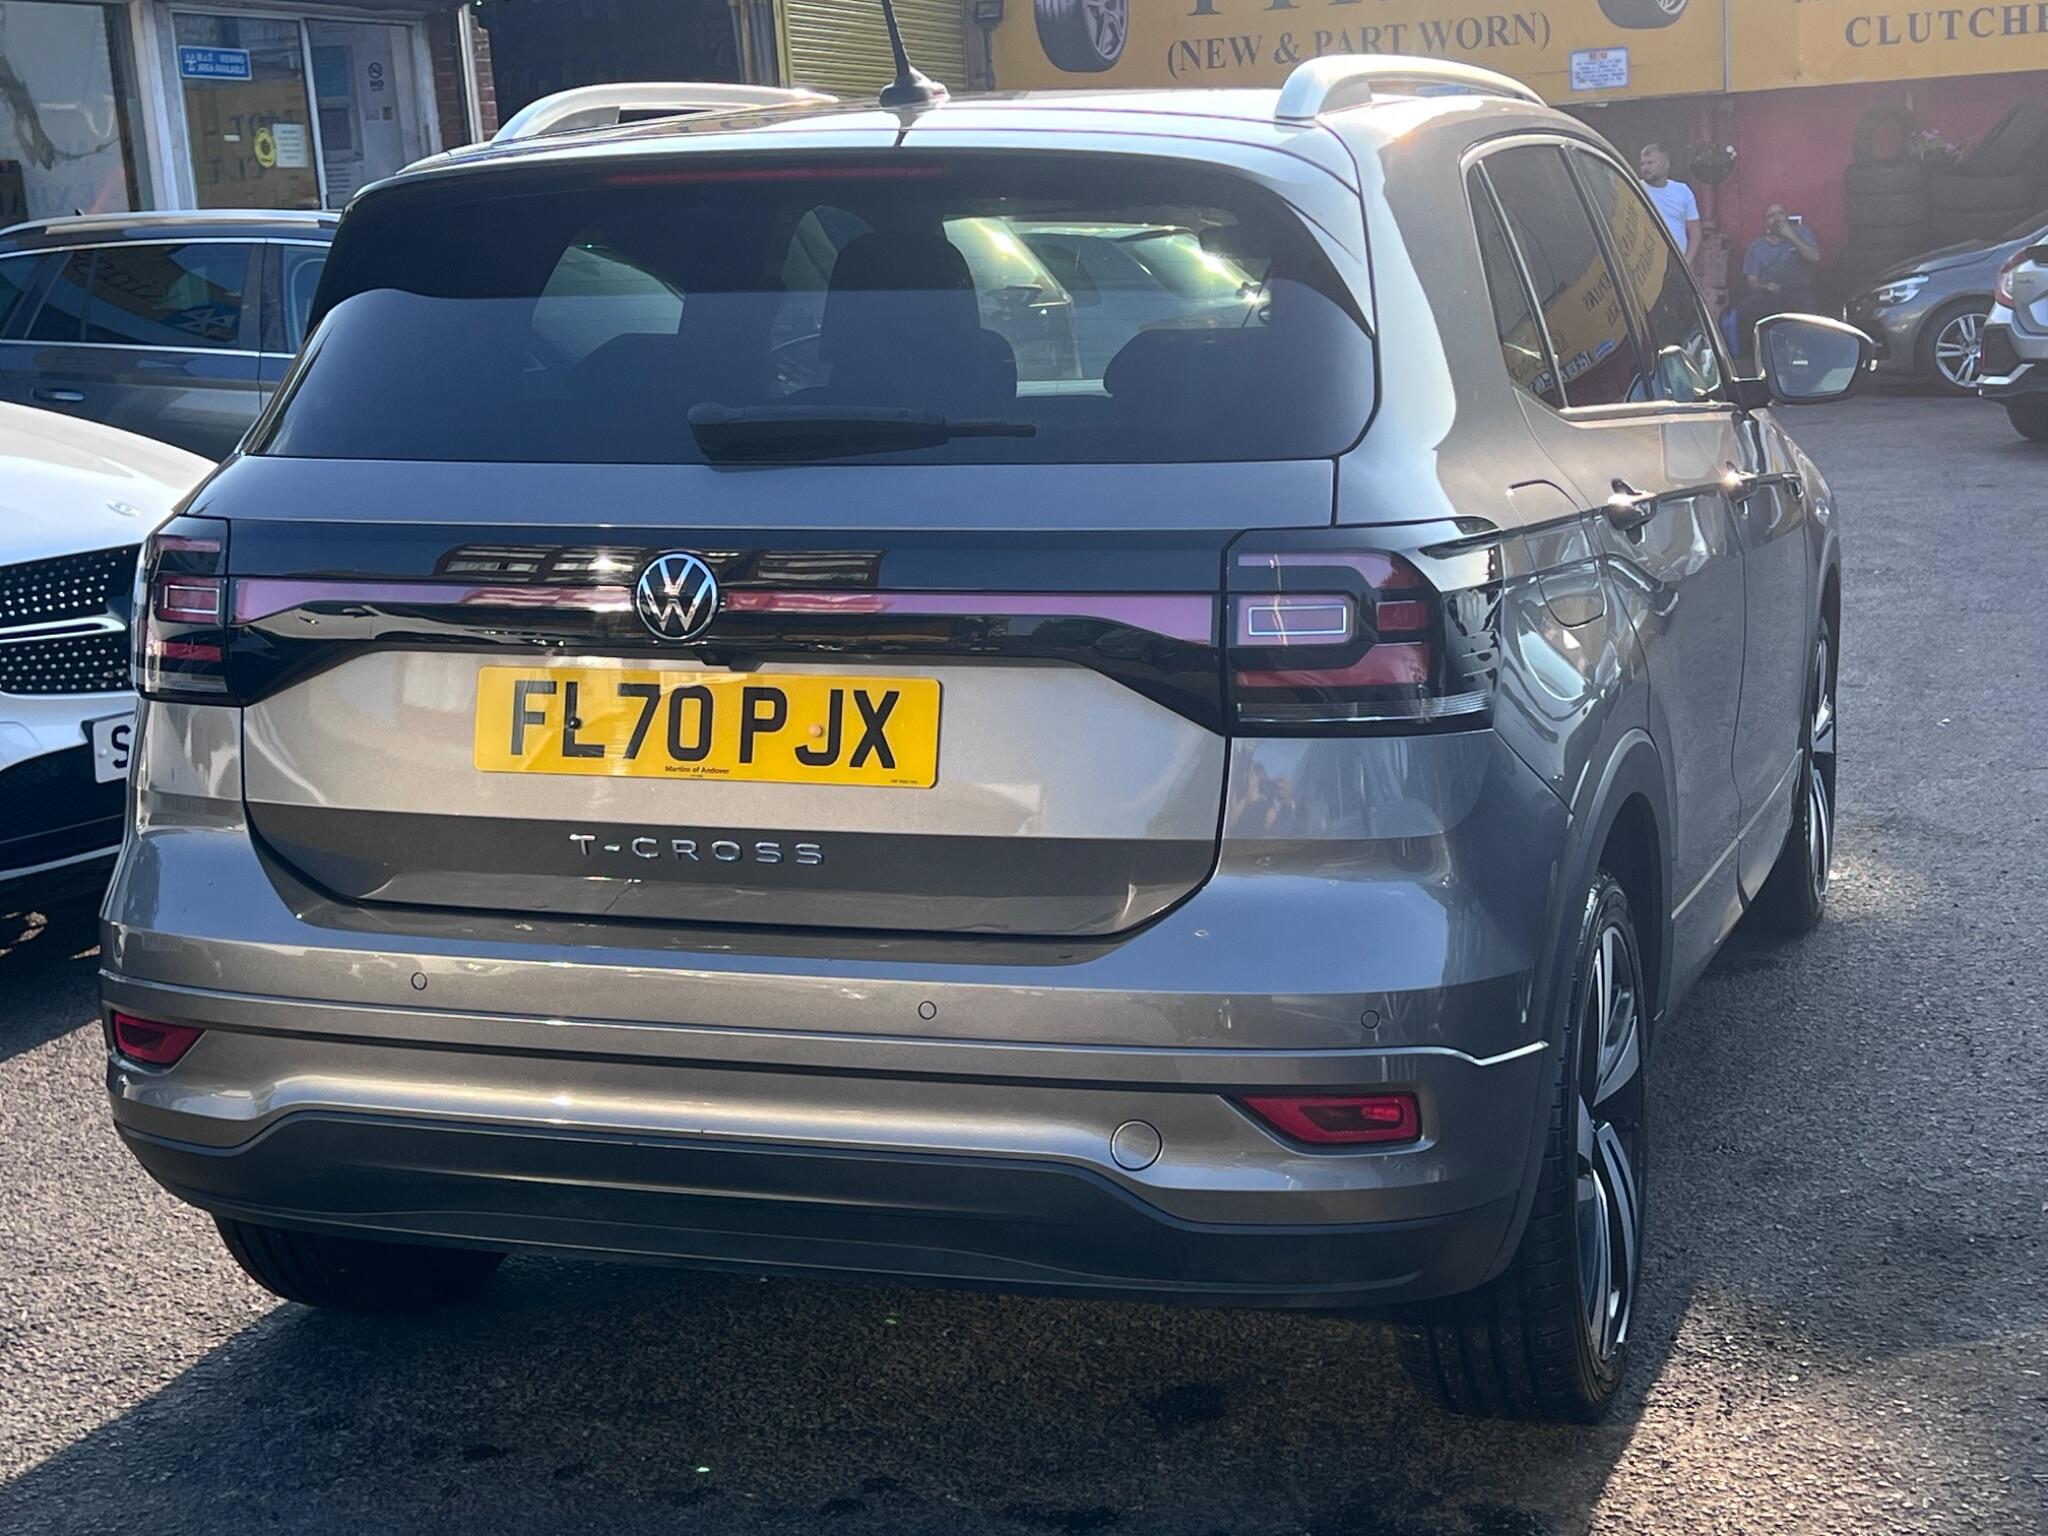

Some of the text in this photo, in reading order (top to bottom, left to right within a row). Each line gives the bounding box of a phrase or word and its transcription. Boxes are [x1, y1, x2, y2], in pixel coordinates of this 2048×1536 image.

[1167, 11, 1552, 80] (NEW & PART WORN)
[111, 724, 132, 770] S
[510, 680, 900, 770] FL70 PJX
[569, 833, 824, 865] T-CROSS
